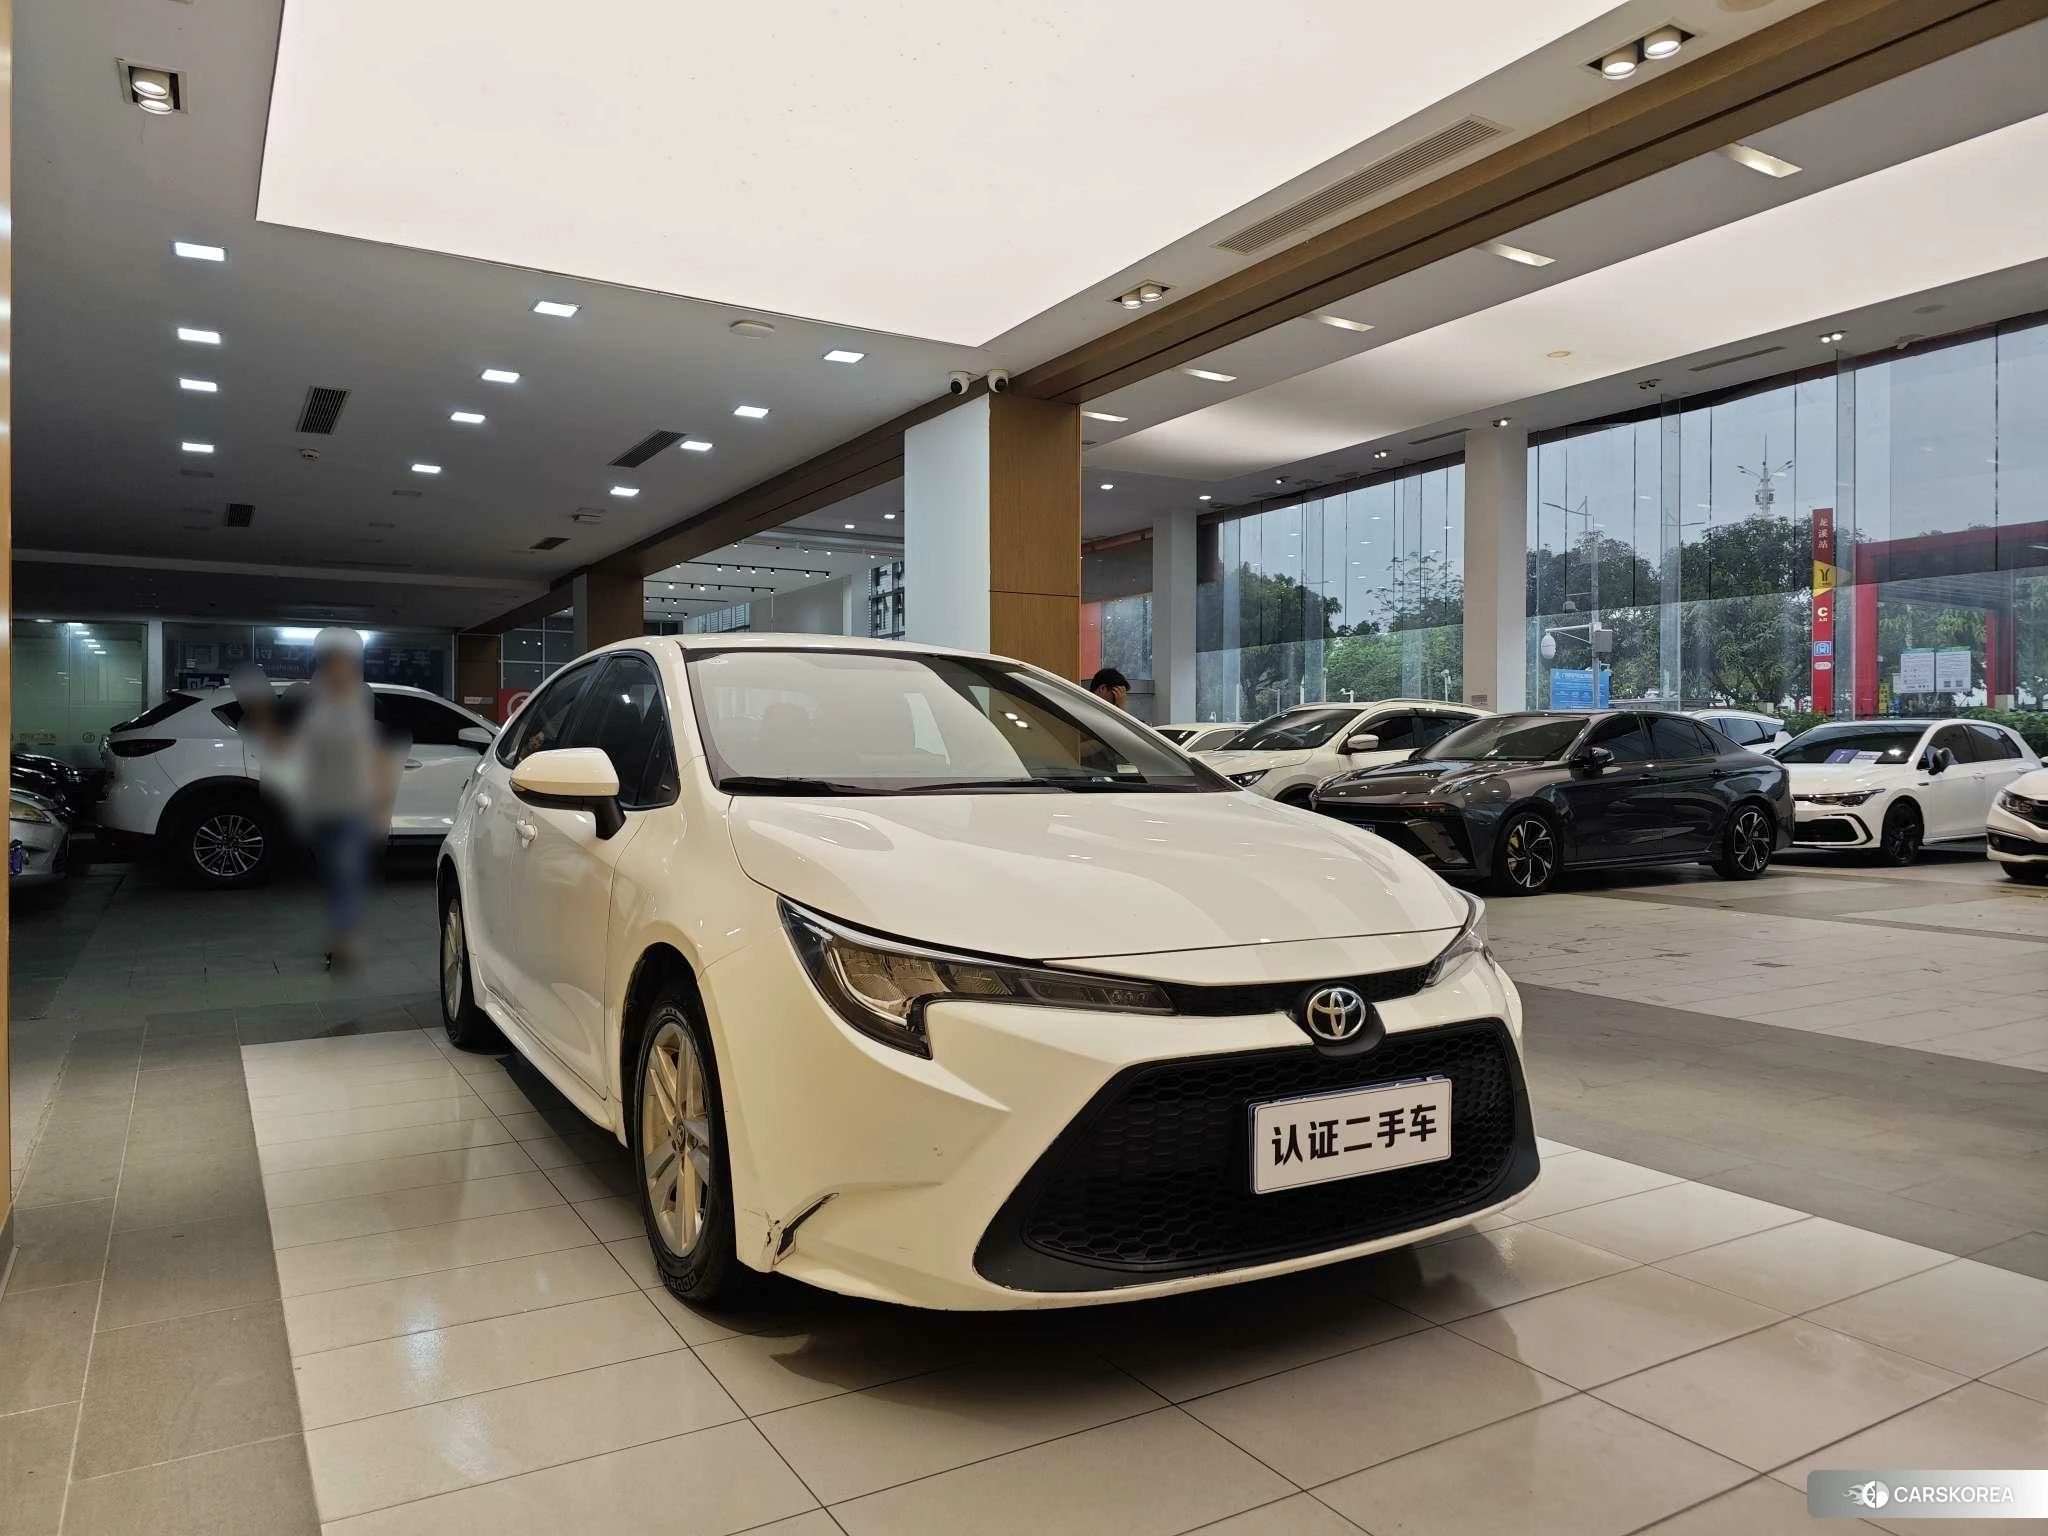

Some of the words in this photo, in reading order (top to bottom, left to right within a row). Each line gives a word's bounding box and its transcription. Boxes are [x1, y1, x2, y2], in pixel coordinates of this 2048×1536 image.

[1817, 607, 1828, 617] C
[1272, 1104, 1437, 1166] 认证二手车
